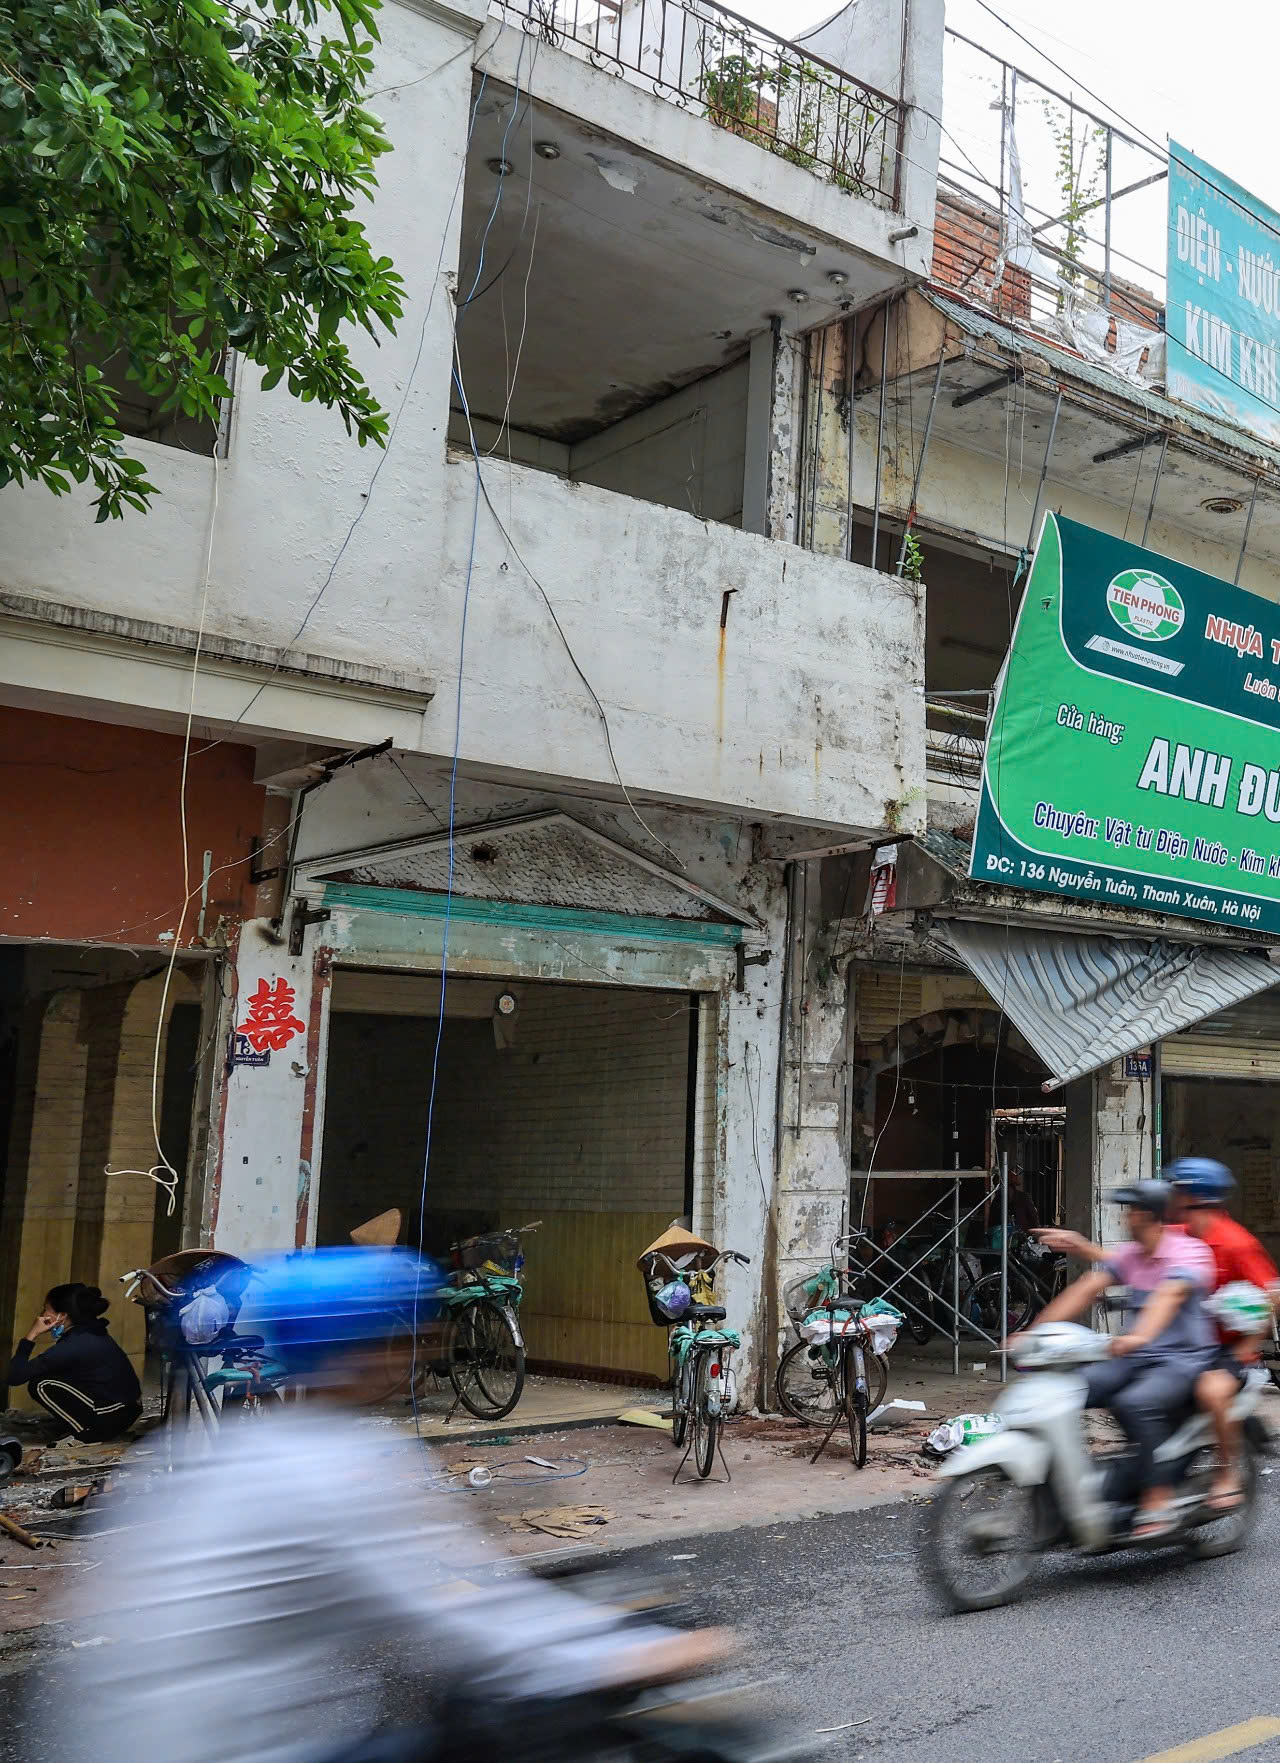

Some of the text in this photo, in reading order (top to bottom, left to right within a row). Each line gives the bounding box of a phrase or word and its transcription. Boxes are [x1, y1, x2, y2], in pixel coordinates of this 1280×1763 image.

[1177, 204, 1220, 286] ĐIỆN
[1185, 300, 1232, 379] KIM
[1113, 587, 1180, 622] TIEN PHONG
[1205, 614, 1263, 658] NHỰA
[1244, 673, 1277, 702] Luôn
[1056, 704, 1125, 745] Cửa hàng:
[1136, 737, 1232, 808] ANH
[1034, 802, 1099, 839] Chuyên:
[1105, 816, 1133, 849] Vật
[1136, 826, 1153, 850] tư
[1156, 829, 1190, 860] Điện
[1192, 837, 1228, 866] Nước
[1239, 848, 1265, 875] Kim
[986, 854, 1262, 924] ĐC: 136 Nguyễn Tuân, Thanh Xuân, Hà Nội
[235, 1040, 266, 1056] 13
